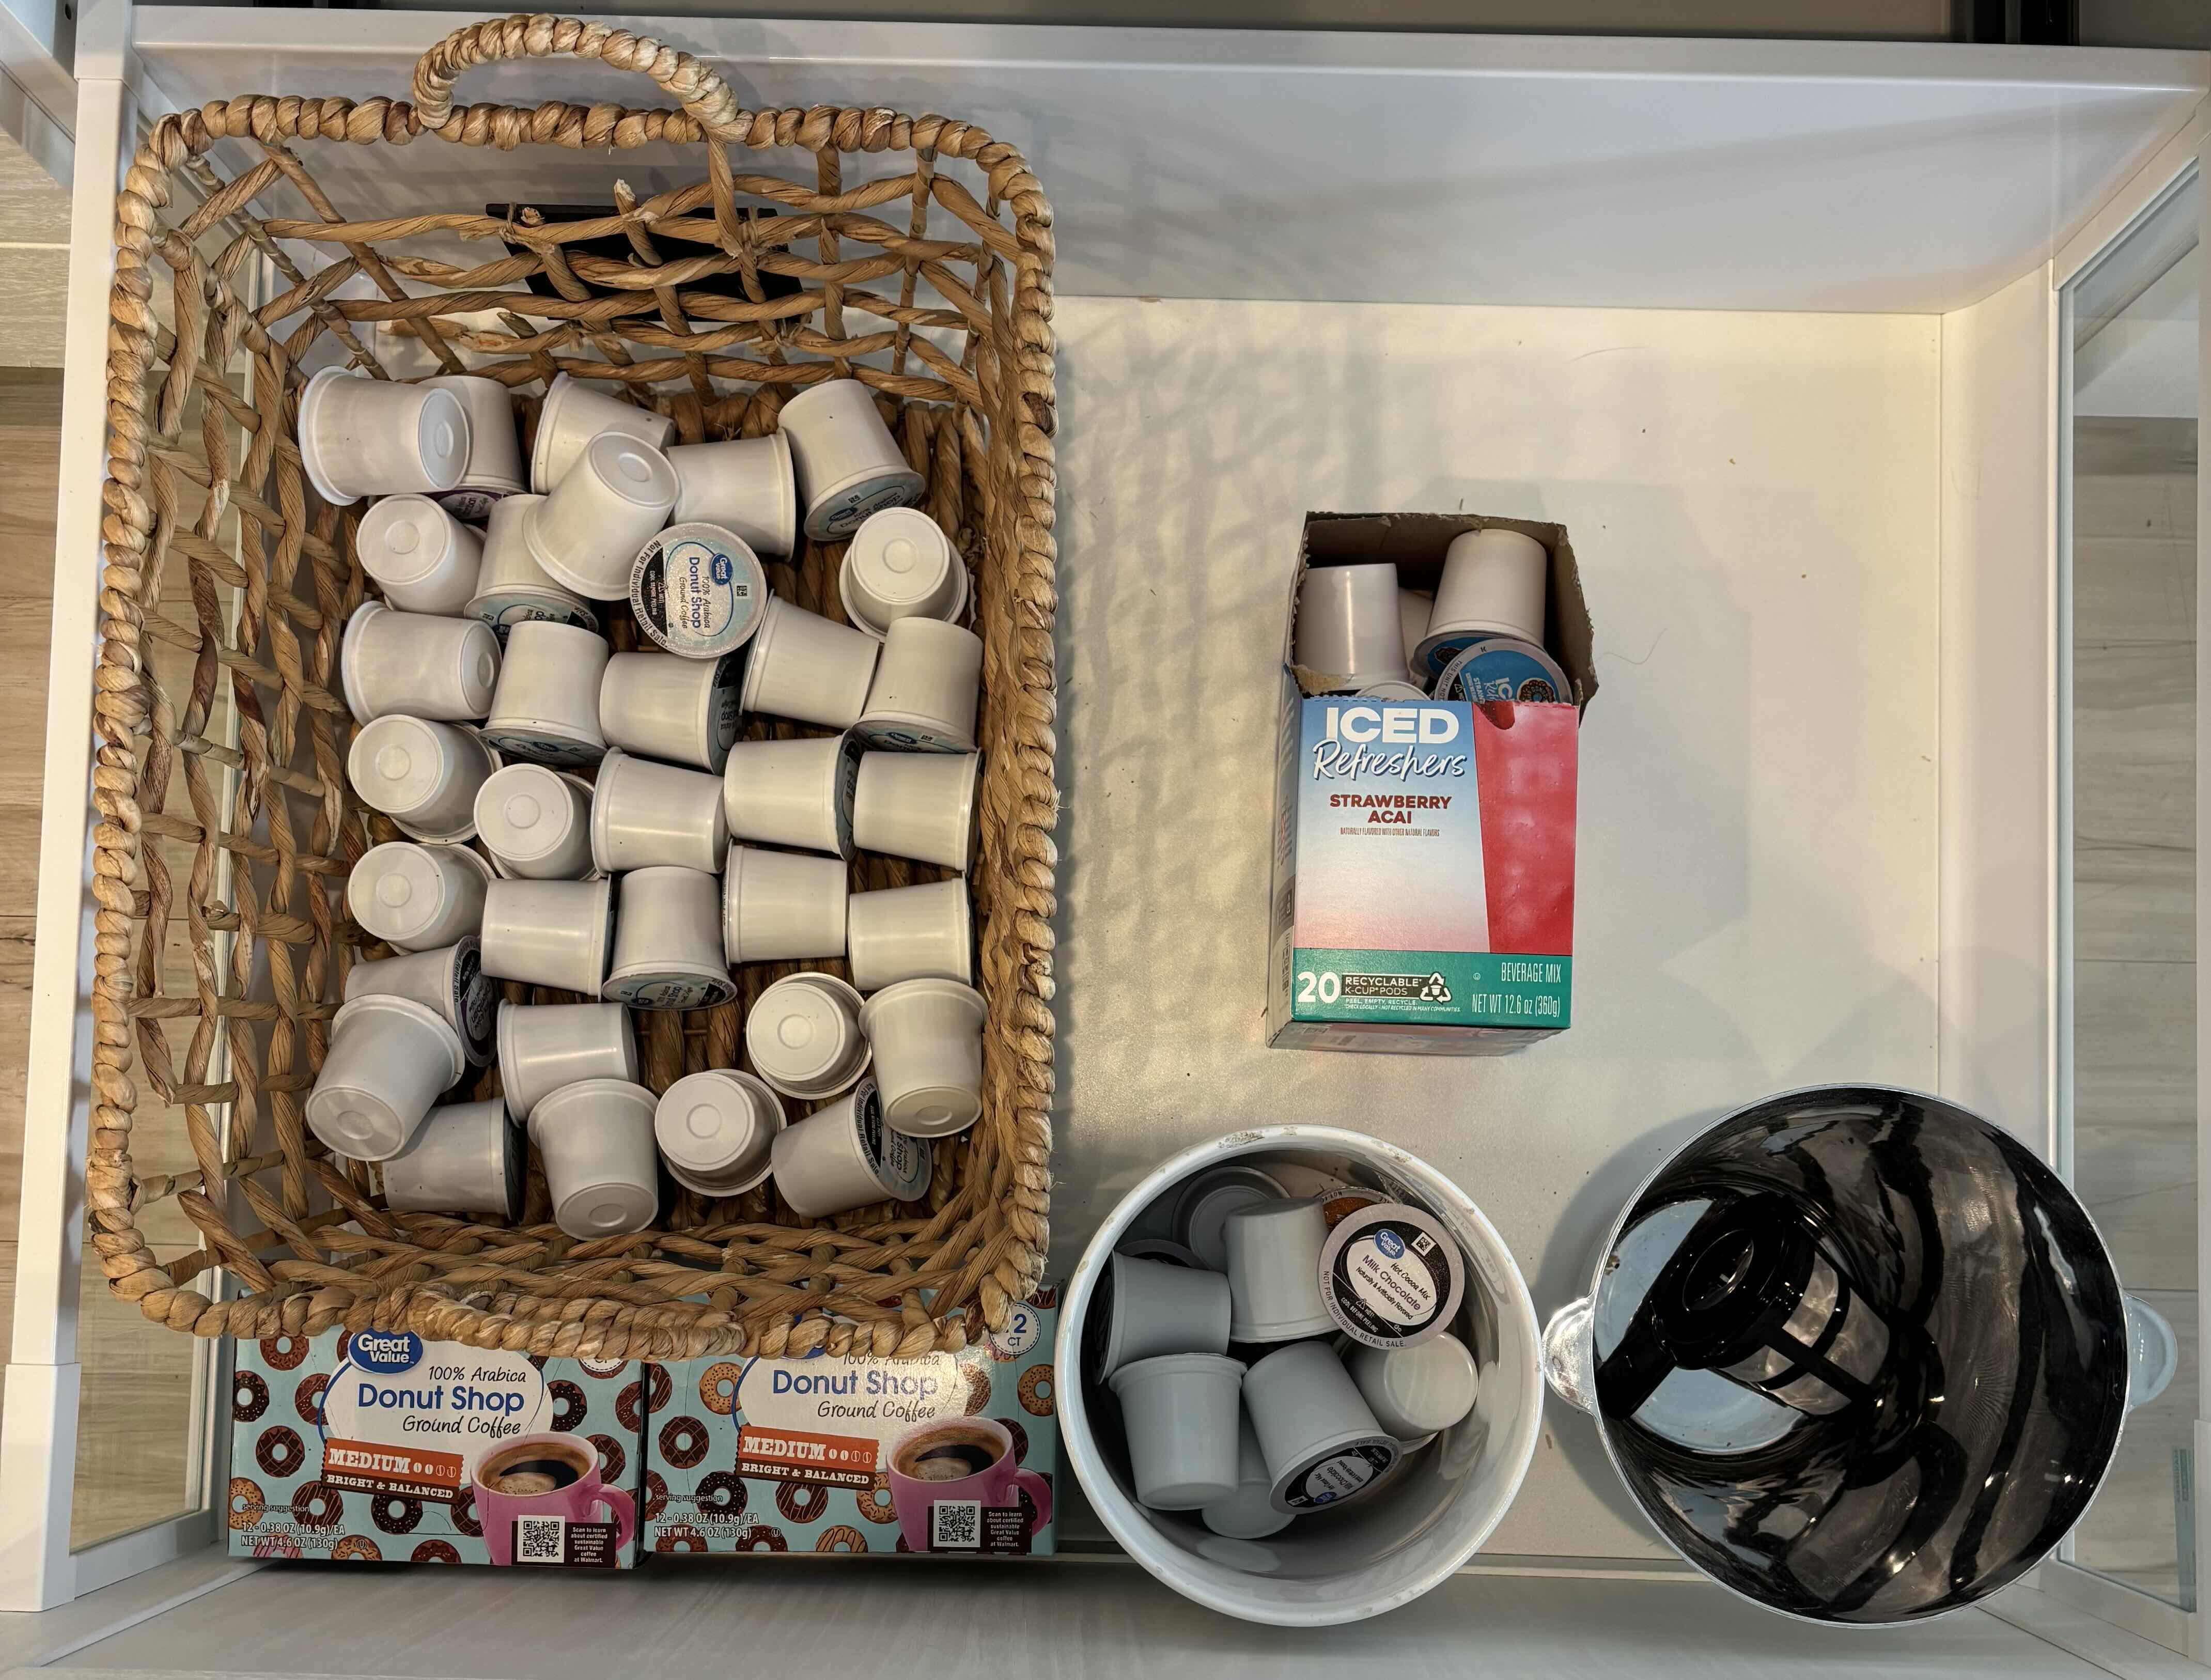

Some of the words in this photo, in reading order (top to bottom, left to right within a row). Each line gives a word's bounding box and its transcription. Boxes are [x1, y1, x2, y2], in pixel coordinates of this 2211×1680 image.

[647, 540, 662, 551] Not
[639, 552, 650, 565] For
[719, 557, 728, 579] Great
[631, 566, 644, 609] Individual
[689, 557, 700, 594] Donut
[679, 577, 689, 604] Ground
[635, 608, 653, 632] Retail
[680, 605, 690, 629] Coffee
[691, 597, 701, 628] Shop
[703, 598, 712, 628] Arabica
[1495, 677, 1513, 701] IC
[1327, 707, 1459, 744] ICED
[1313, 739, 1467, 781] Refreshers
[1330, 794, 1452, 809] STRAWBERRY
[1368, 811, 1412, 823] ACAI
[1501, 962, 1543, 983] BEVERAGE
[1546, 963, 1561, 983] MIX
[1297, 971, 1341, 1003] 20
[1380, 987, 1408, 995] PODS
[1472, 994, 1487, 1013] NET
[1489, 994, 1502, 1013] WT
[1505, 994, 1521, 1014] 12.6
[1524, 1000, 1533, 1014] oz
[1535, 995, 1560, 1018] (360g)
[856, 1098, 866, 1131] Individual
[860, 1133, 871, 1157] Retail
[1380, 1232, 1401, 1252] Great
[1356, 1266, 1375, 1285] Naturally
[1376, 1286, 1396, 1305] Artificially
[1394, 1301, 1414, 1320] Flavored
[1362, 1254, 1381, 1273] Milk
[1380, 1271, 1421, 1310] Chocolate
[1391, 1263, 1403, 1275] Hot
[1400, 1272, 1419, 1290] Cocoa
[1419, 1287, 1431, 1301] Mix
[1325, 1286, 1333, 1301] FOR
[1330, 1302, 1358, 1335] INDIVIDUAL
[1359, 1332, 1383, 1346] RETAIL
[358, 1334, 410, 1353] Great
[1007, 1337, 1021, 1346] CT
[369, 1350, 410, 1363] Value
[844, 1350, 879, 1365] 100%
[429, 1366, 465, 1381] 100%
[471, 1366, 526, 1382] Arabica
[773, 1370, 859, 1395] Donut
[866, 1370, 939, 1401] Shop
[358, 1383, 444, 1409] Donut
[451, 1385, 524, 1417] Shop
[817, 1399, 879, 1418] Ground
[882, 1400, 936, 1422] Coffee
[402, 1414, 464, 1434] Ground
[468, 1416, 521, 1438] Coffee
[742, 1436, 827, 1461] MEDIUM
[328, 1448, 411, 1474] MEDIUM
[741, 1463, 790, 1477] BRIGHT
[791, 1468, 801, 1477] &
[804, 1469, 870, 1485] BALANCED
[326, 1474, 375, 1489] BRIGHT
[377, 1482, 386, 1490] &
[388, 1483, 454, 1499] BALANCED
[656, 1493, 682, 1503] serving
[682, 1494, 724, 1503] suggestion
[242, 1503, 269, 1513] serving
[269, 1504, 310, 1513] suggestion
[655, 1513, 667, 1523] 12
[673, 1513, 695, 1524] 0.38
[696, 1513, 709, 1524] OZ
[709, 1513, 759, 1527] (10.9g)/EA
[242, 1522, 253, 1533] 12
[260, 1522, 281, 1533] 0.38
[283, 1523, 295, 1534] OZ
[296, 1523, 346, 1536] (10.9g)/EA
[654, 1527, 672, 1538] NET
[673, 1527, 689, 1538] WT
[690, 1527, 706, 1538] 4.6
[707, 1528, 720, 1538] OZ
[720, 1527, 752, 1541] (130g)
[241, 1536, 258, 1547] NET
[260, 1536, 275, 1547] WT
[277, 1537, 292, 1548] 4.6
[293, 1537, 307, 1548] OZ
[307, 1537, 338, 1551] (130g)
